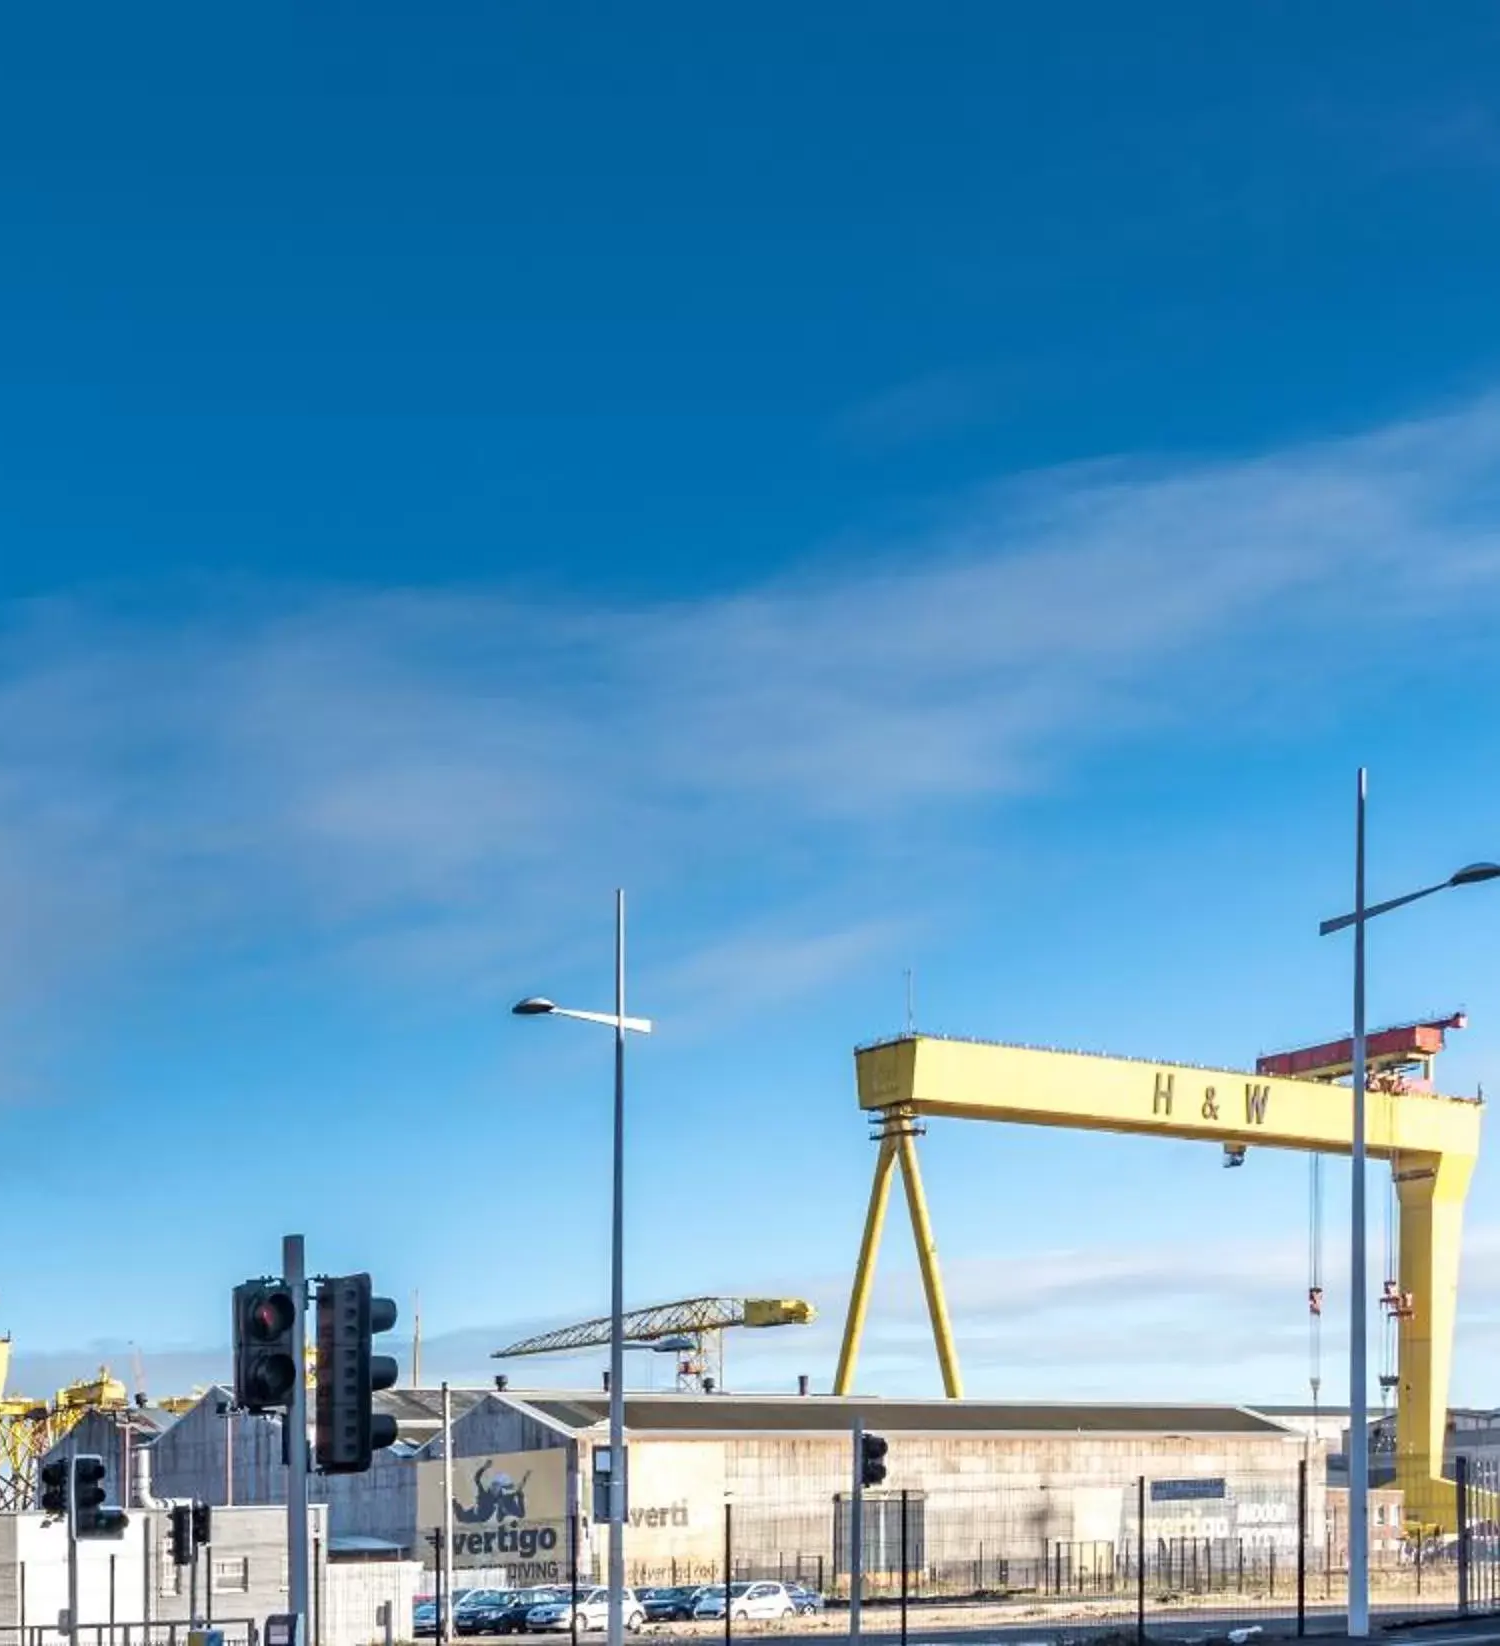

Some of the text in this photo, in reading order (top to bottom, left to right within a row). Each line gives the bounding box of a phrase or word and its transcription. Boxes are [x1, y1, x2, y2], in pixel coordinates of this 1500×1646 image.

[1153, 1072, 1270, 1124] H & W
[452, 1520, 557, 1558] vertigo
